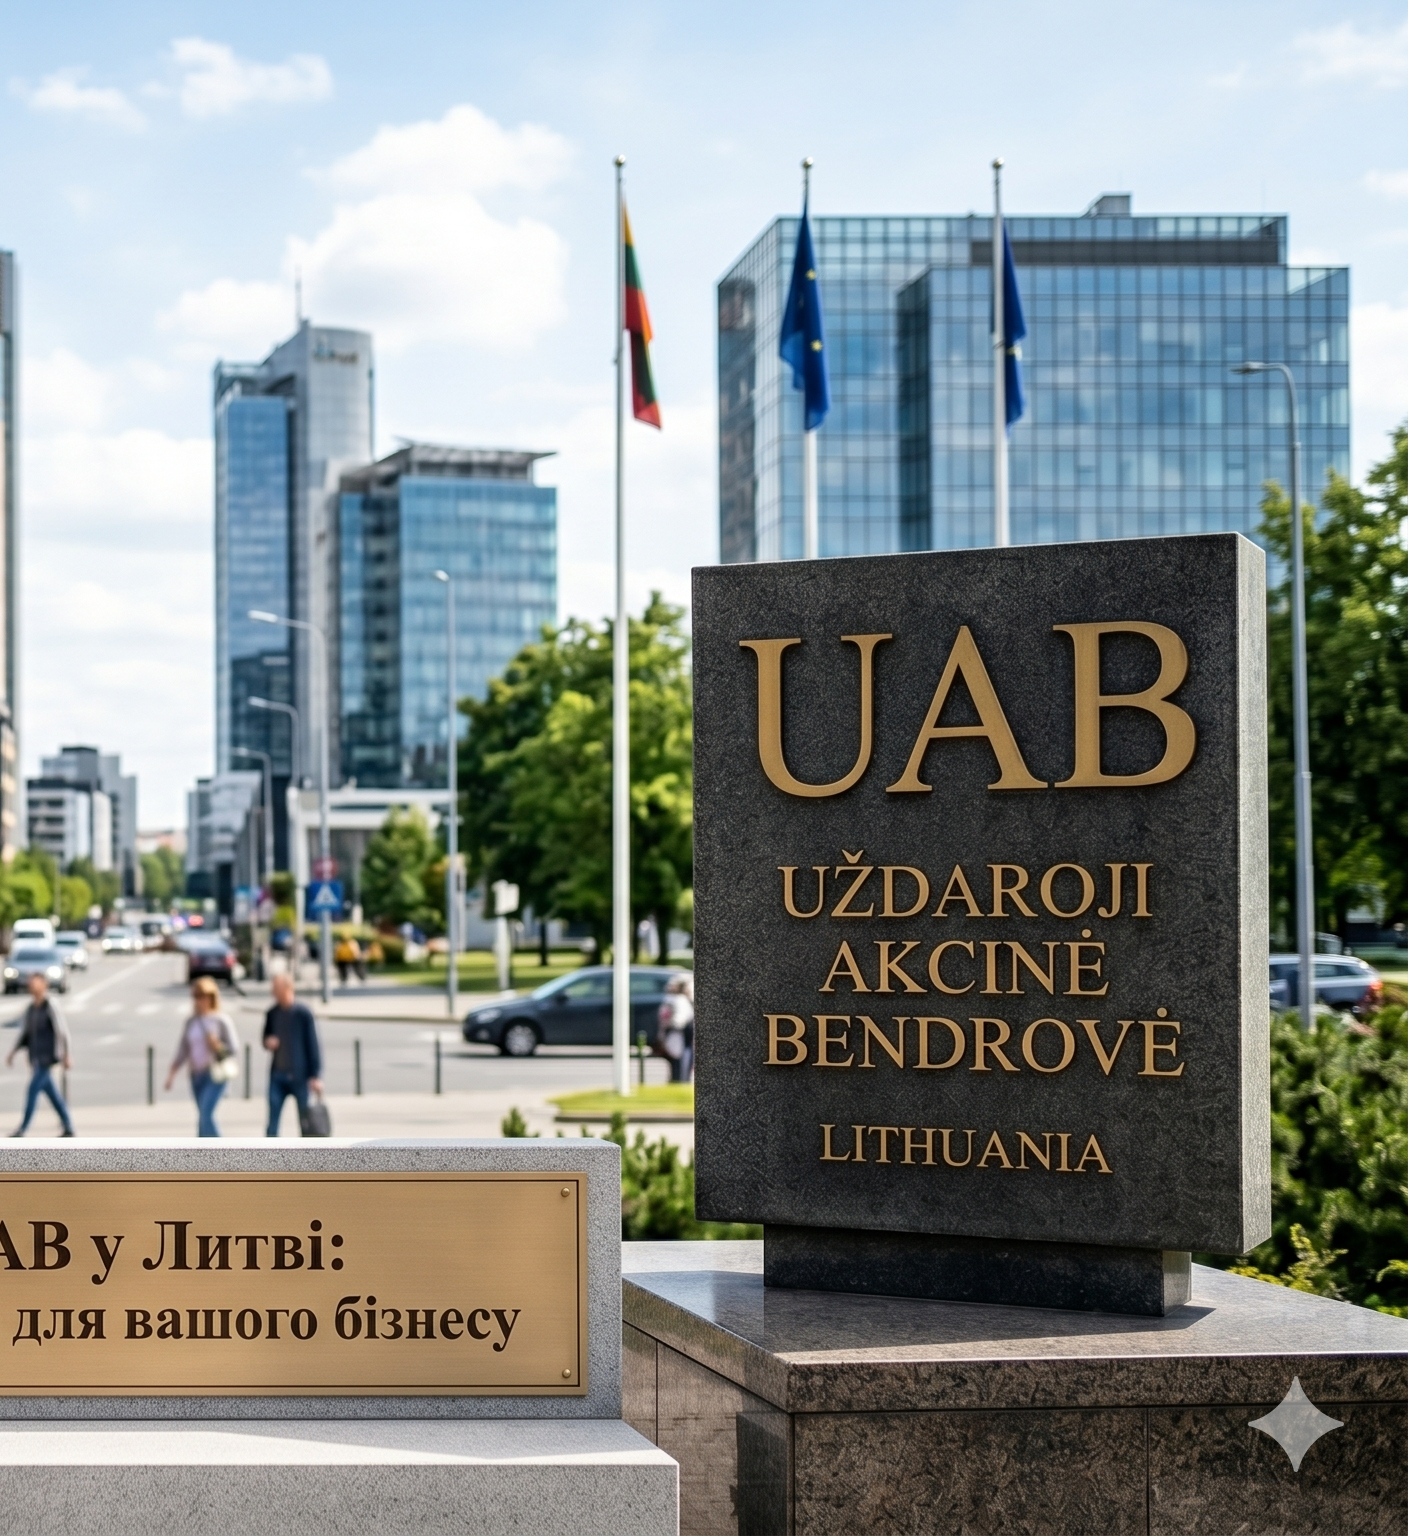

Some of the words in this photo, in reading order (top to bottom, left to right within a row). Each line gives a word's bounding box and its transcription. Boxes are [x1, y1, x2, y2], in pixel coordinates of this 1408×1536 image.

[739, 621, 1196, 798] UAB
[777, 849, 1154, 918] UŽDAROJI
[818, 929, 1109, 996] AKCINĖ
[763, 1007, 1185, 1077] BENDROVĖ
[819, 1124, 1113, 1174] LITHUANIA
[90, 1235, 124, 1285] у
[142, 1219, 345, 1271] Литві:
[12, 1307, 107, 1346] для
[124, 1307, 318, 1340] вашого
[334, 1295, 521, 1352] бізнесу
